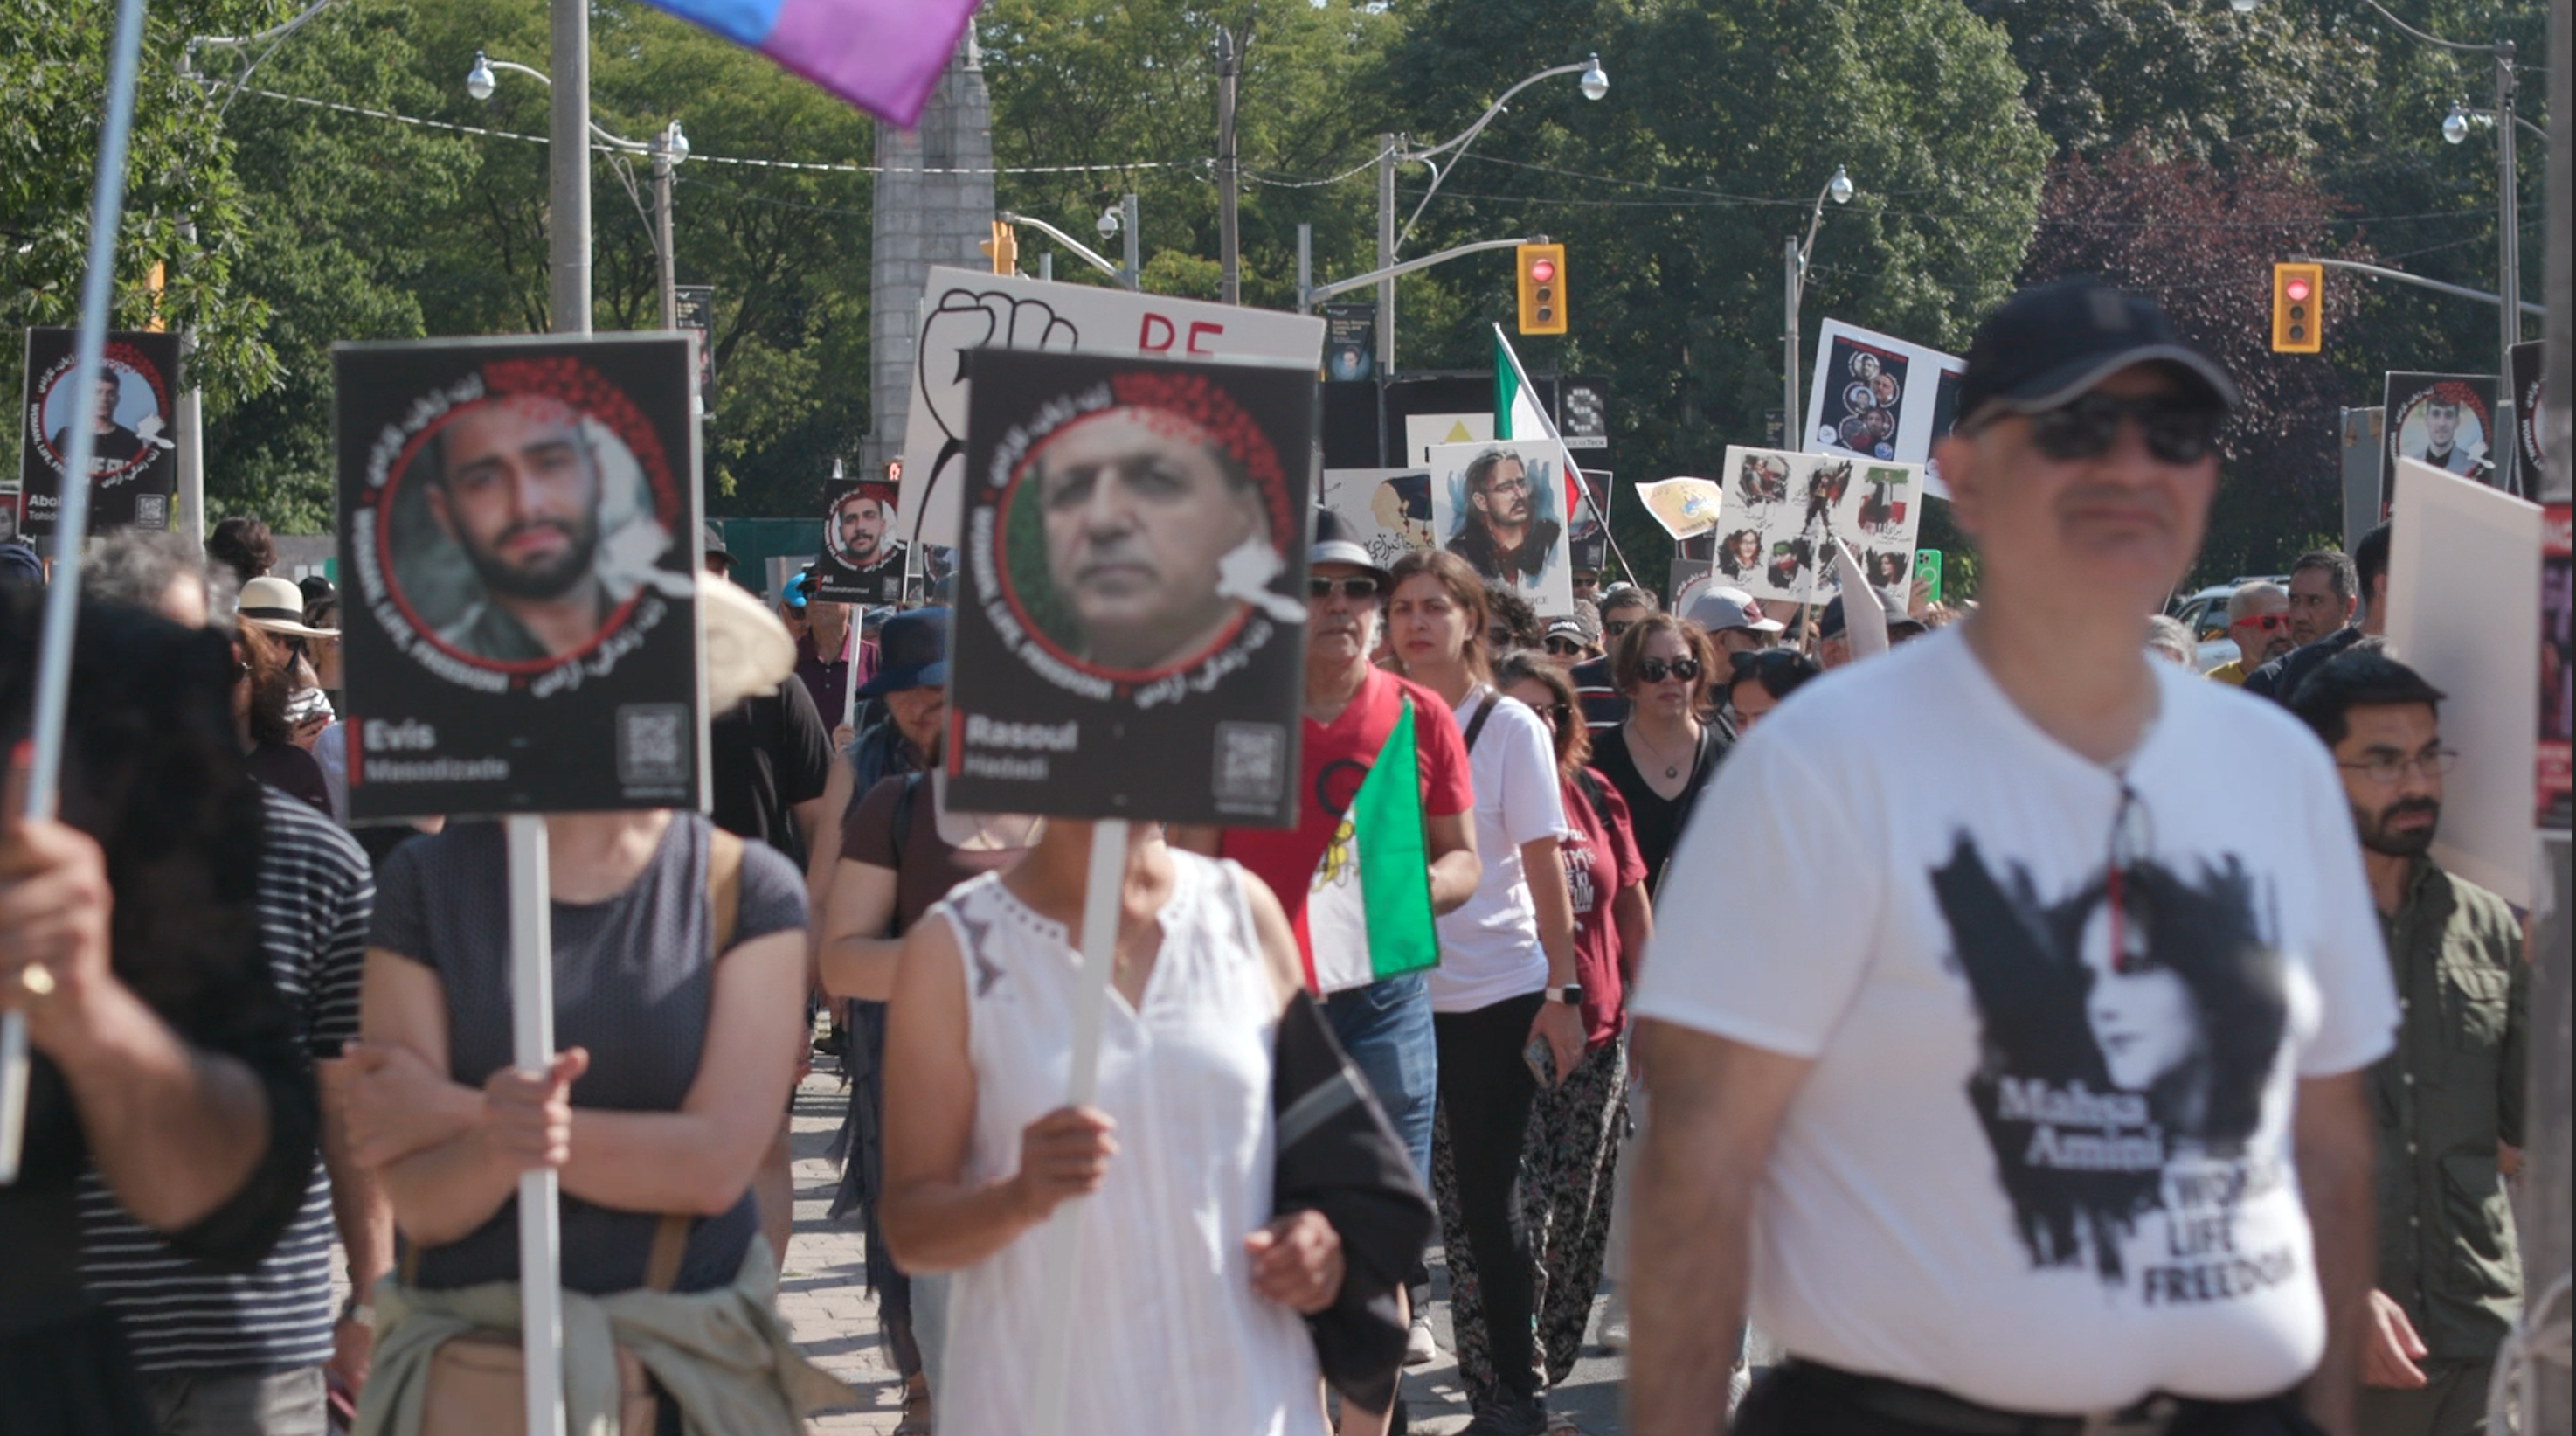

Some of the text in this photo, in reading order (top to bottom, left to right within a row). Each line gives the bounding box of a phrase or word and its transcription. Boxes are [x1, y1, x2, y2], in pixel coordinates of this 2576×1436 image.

[364, 718, 436, 751] Evis
[966, 713, 1078, 753] Rasoul
[1996, 1076, 2149, 1127] Mahsa
[2025, 1122, 2164, 1170] Amini
